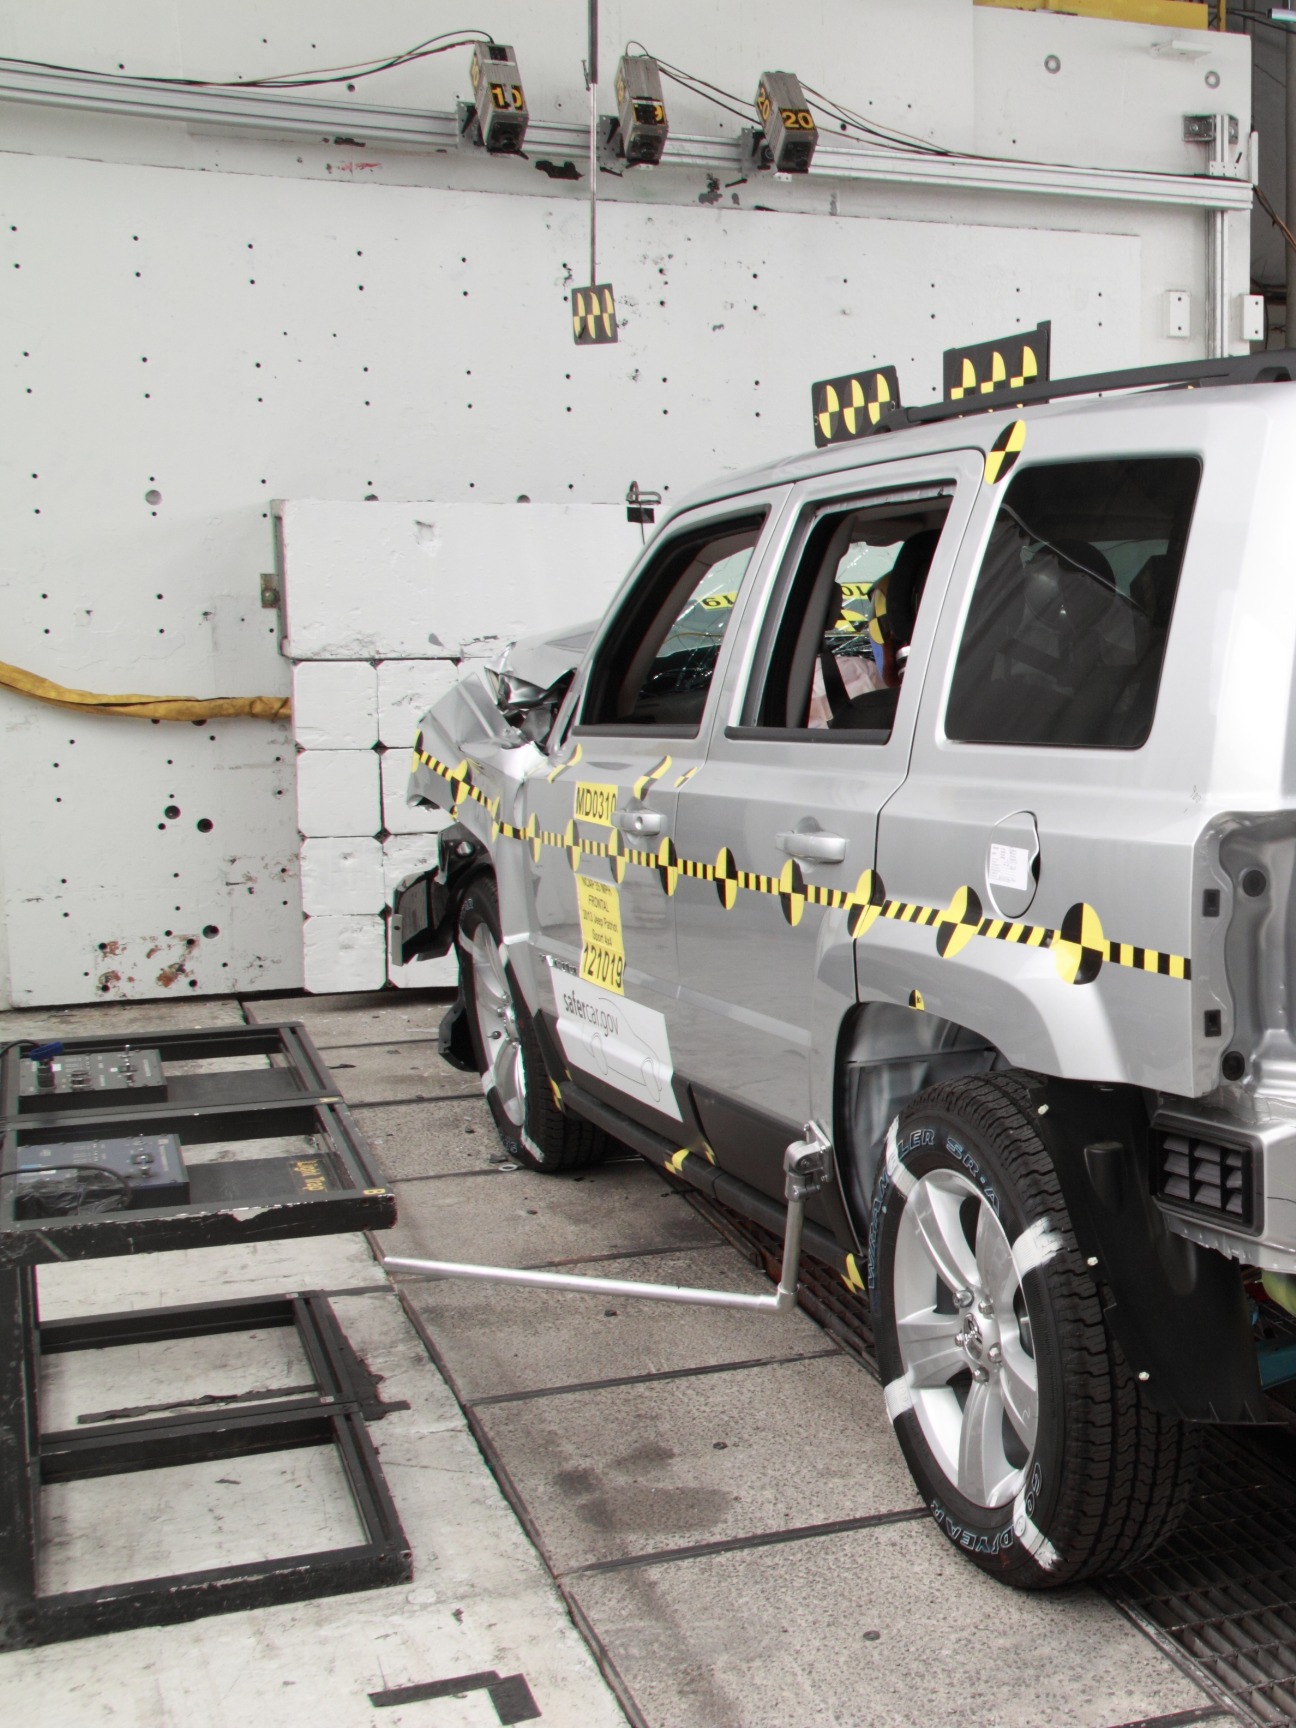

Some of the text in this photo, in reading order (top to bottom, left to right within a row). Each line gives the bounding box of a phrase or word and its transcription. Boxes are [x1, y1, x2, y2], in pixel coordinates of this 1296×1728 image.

[781, 110, 815, 129] 20
[575, 786, 617, 821] MD0310
[583, 942, 624, 989] 121019
[563, 989, 619, 1037] safercar.gov
